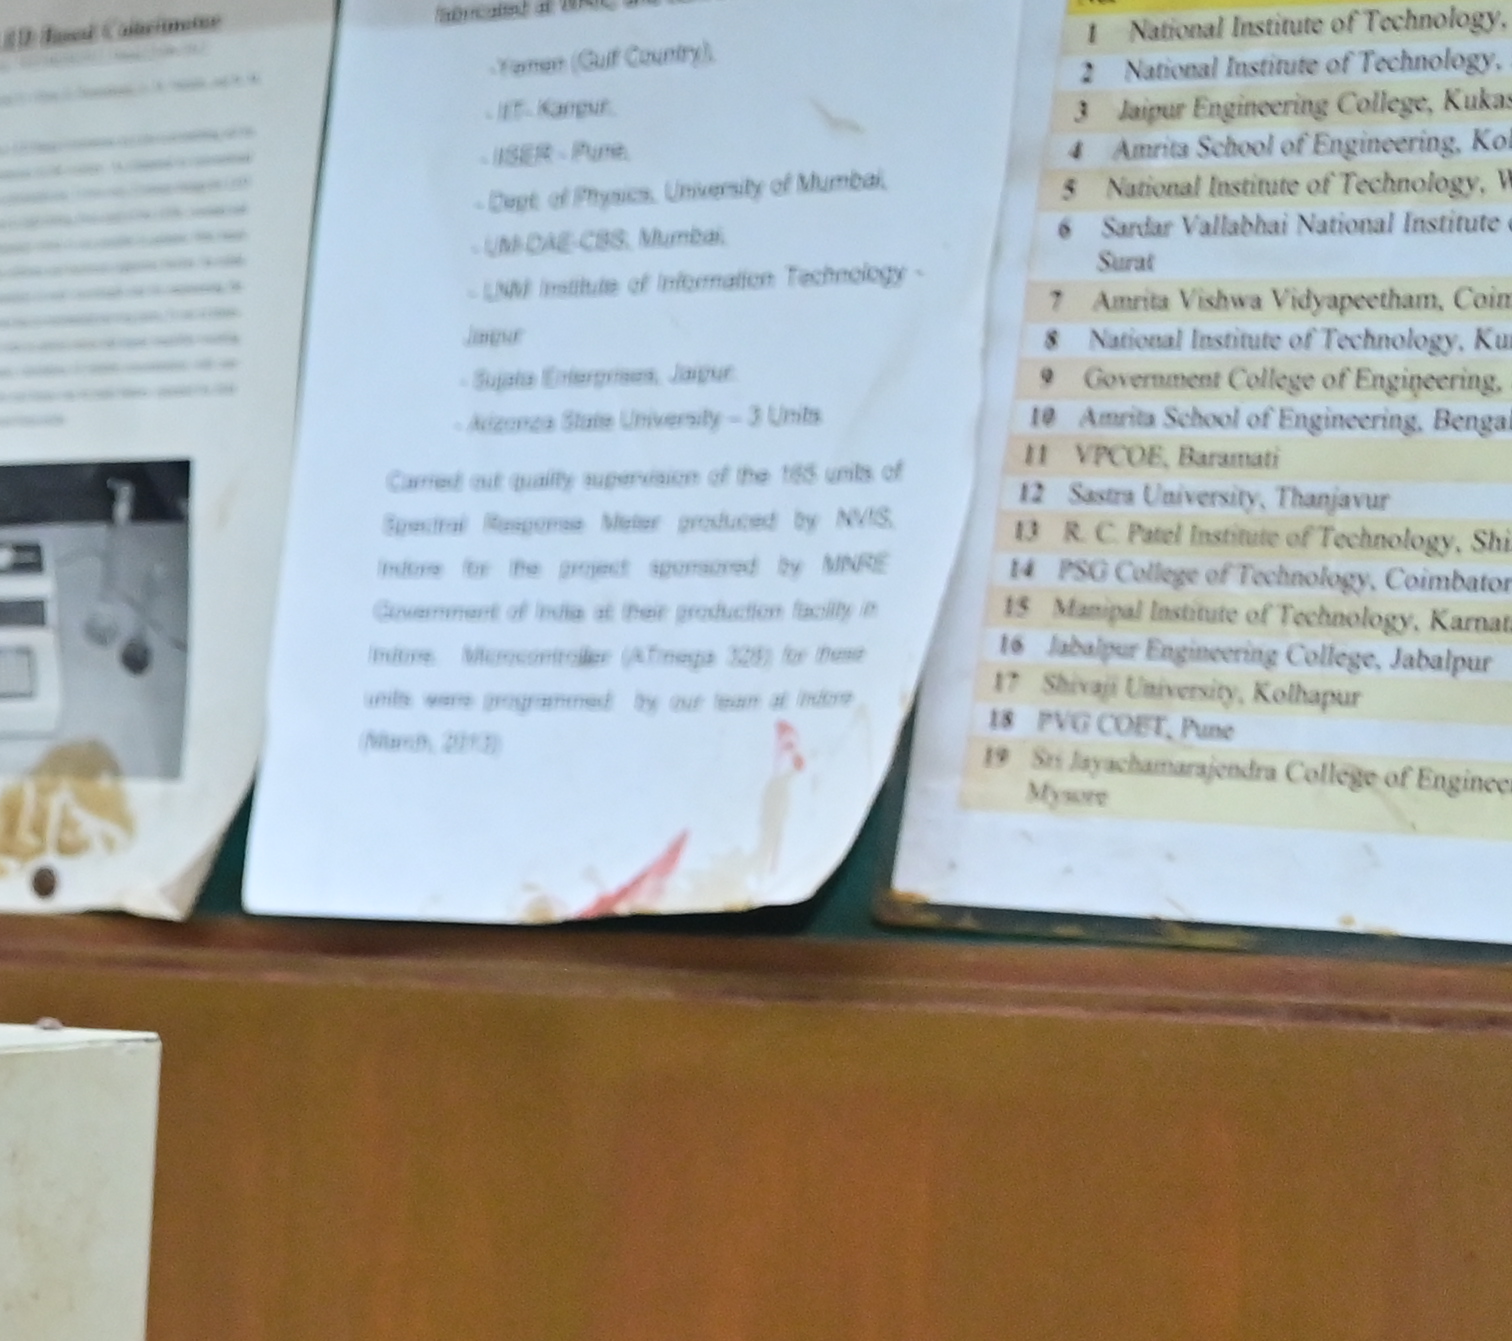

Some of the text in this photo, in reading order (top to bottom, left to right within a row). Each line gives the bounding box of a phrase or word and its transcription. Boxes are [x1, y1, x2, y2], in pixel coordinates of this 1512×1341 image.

[1130, 15, 1223, 42] National
[1232, 13, 1323, 38] Institute
[1331, 9, 1360, 34] of
[1080, 61, 1093, 84] 2
[1125, 56, 1218, 82] National
[1227, 53, 1318, 78] Institute
[1326, 50, 1355, 75] of
[1074, 100, 1087, 123] 3
[1119, 98, 1187, 125] Jaipur
[1193, 93, 1328, 124] Engineering
[1337, 90, 1433, 119] College,
[1068, 139, 1083, 160] 4
[1113, 136, 1189, 160] Amrita
[1196, 134, 1274, 159] School
[1280, 132, 1309, 156] of
[1062, 178, 1076, 200] 5
[1107, 174, 1201, 199] National
[1209, 173, 1299, 198] Institute
[1306, 171, 1335, 195] of
[1057, 217, 1072, 240] 6
[1101, 215, 1173, 239] Sardar
[1297, 212, 1394, 236] National
[1403, 209, 1501, 235] Institute
[785, 262, 908, 289] Technology
[1096, 250, 1155, 273] Surat
[1050, 289, 1063, 311] 7
[1091, 288, 1169, 312] Amrita
[1180, 287, 1263, 311] Vishwa
[1044, 329, 1059, 350] 8
[1089, 327, 1183, 351] National
[1191, 327, 1281, 350] Institute
[1288, 327, 1317, 350] of
[1040, 366, 1054, 389] 9
[1083, 366, 1220, 390] Government
[1228, 366, 1315, 396] College
[1321, 366, 1351, 390] of
[1031, 405, 1056, 428] 10
[1079, 405, 1155, 429] Amrita
[1164, 405, 1240, 429] School
[1246, 406, 1274, 430] of
[1025, 443, 1047, 466] 11
[1179, 444, 1280, 469] Baramati
[1020, 481, 1044, 504] 12
[1068, 481, 1134, 506] Sastra
[1277, 485, 1391, 516] Thanjavur
[1016, 519, 1039, 542] 13
[1128, 521, 1181, 546] Patel
[1190, 522, 1279, 548] Institute
[1286, 524, 1314, 549] of
[1011, 558, 1034, 580] 14
[1115, 559, 1198, 590] College
[1205, 562, 1233, 585] of
[1005, 596, 1030, 618] 15
[1151, 598, 1238, 625] Institute
[1245, 602, 1273, 626] of
[1000, 633, 1024, 656] 16
[1147, 637, 1278, 670] Engineering
[1390, 645, 1492, 678] Jabalpur
[995, 670, 1020, 693] 17
[1253, 681, 1362, 714] Kolhapur
[989, 708, 1014, 731] 18
[1180, 716, 1235, 741] Pune
[1285, 759, 1378, 793] College
[1384, 765, 1413, 789] of
